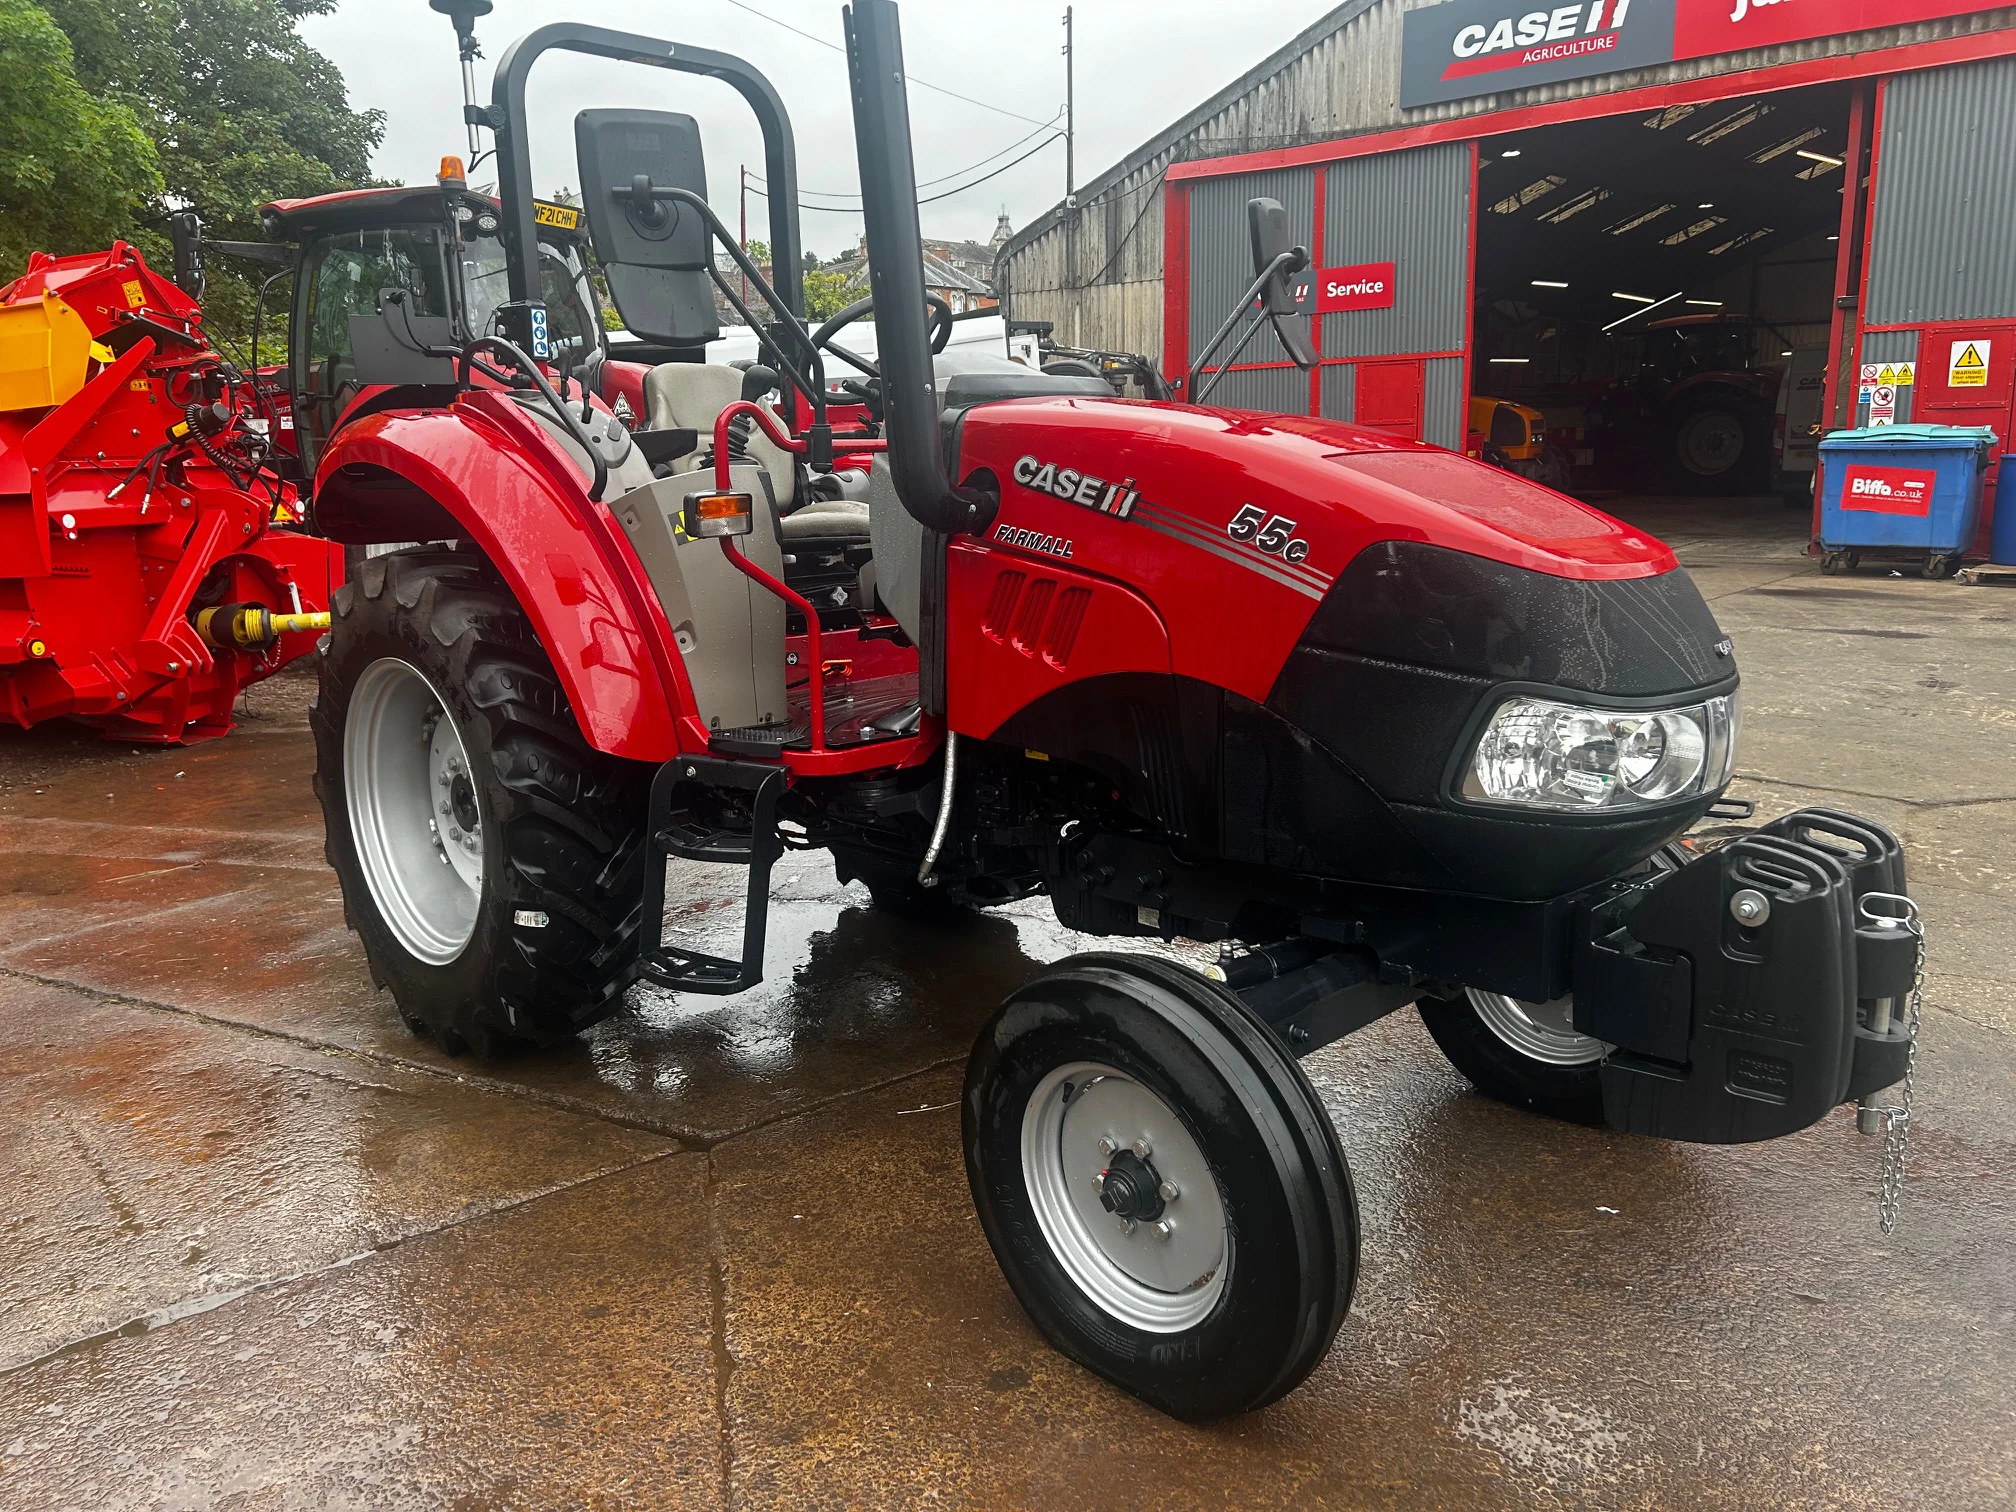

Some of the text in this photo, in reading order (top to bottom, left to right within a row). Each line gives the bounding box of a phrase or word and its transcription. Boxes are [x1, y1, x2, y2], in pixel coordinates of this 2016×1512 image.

[1452, 4, 1583, 58] CASE
[1521, 36, 1614, 64] AGRICULTURE
[556, 210, 573, 226] CHH
[1327, 278, 1384, 298] Service
[1012, 455, 1107, 507] CASE
[1851, 477, 1924, 499] Biffa.co.uk
[993, 523, 1074, 559] FARMALL
[1710, 1004, 1776, 1027] CASE
